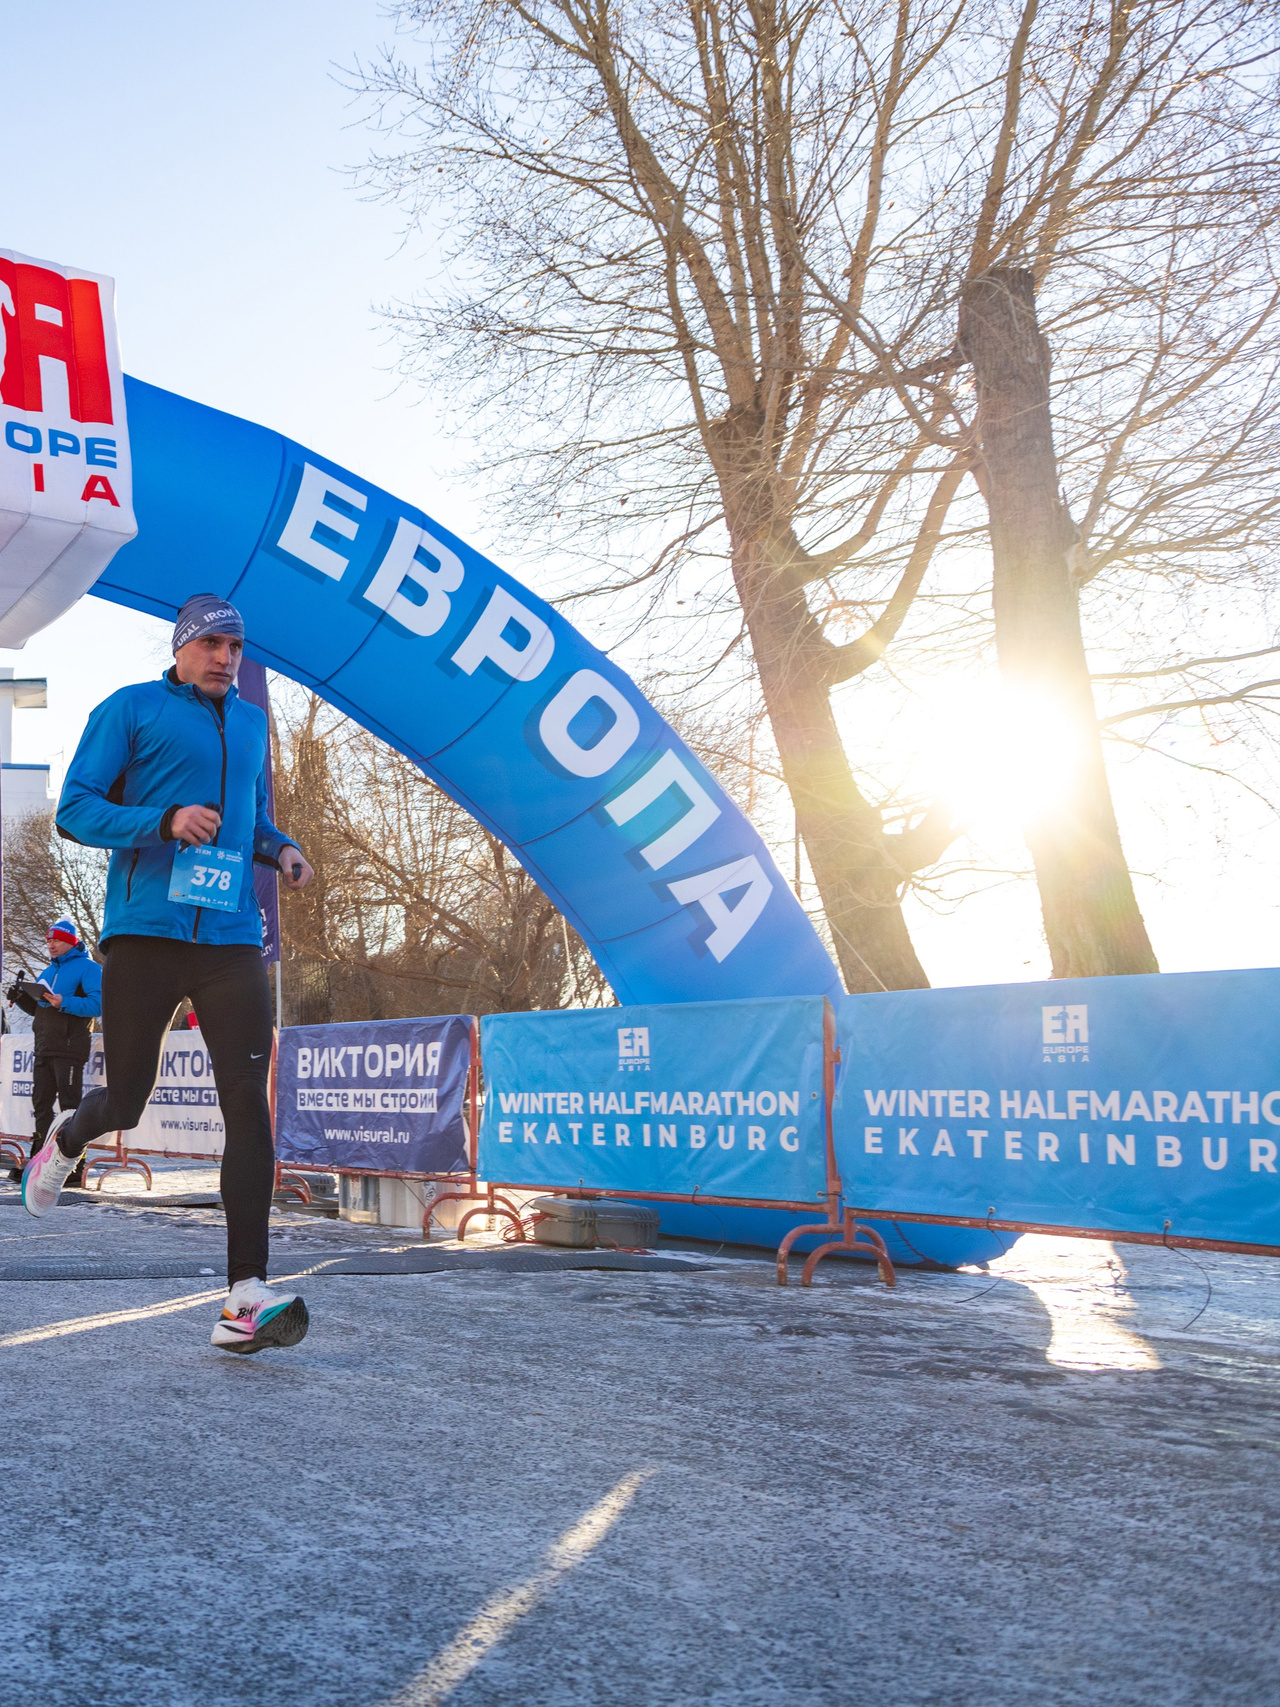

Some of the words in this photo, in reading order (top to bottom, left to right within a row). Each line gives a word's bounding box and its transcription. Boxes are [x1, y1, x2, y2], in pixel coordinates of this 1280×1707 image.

[177, 623, 200, 647] URAL
[277, 462, 774, 963] ЕВРОПА
[190, 865, 232, 891] 378
[297, 1042, 442, 1079] ВИКТОРИЯ
[1042, 1055, 1090, 1063] ASIA
[1043, 1046, 1089, 1054] EUROPE
[181, 1090, 199, 1103] мы
[298, 1092, 349, 1107] вместе
[354, 1093, 376, 1108] мы
[380, 1092, 434, 1112] строим
[498, 1092, 584, 1114] WINTER
[589, 1090, 799, 1116] HALFMARATHON
[864, 1089, 991, 1119] WINTER
[999, 1090, 1280, 1125] HALFMARATHO
[160, 1117, 224, 1132] www.visural.ru
[323, 1126, 410, 1144] www.visural.ru
[498, 1121, 799, 1152] EKATERINBURG
[864, 1126, 1278, 1173] EKATERINBUR
